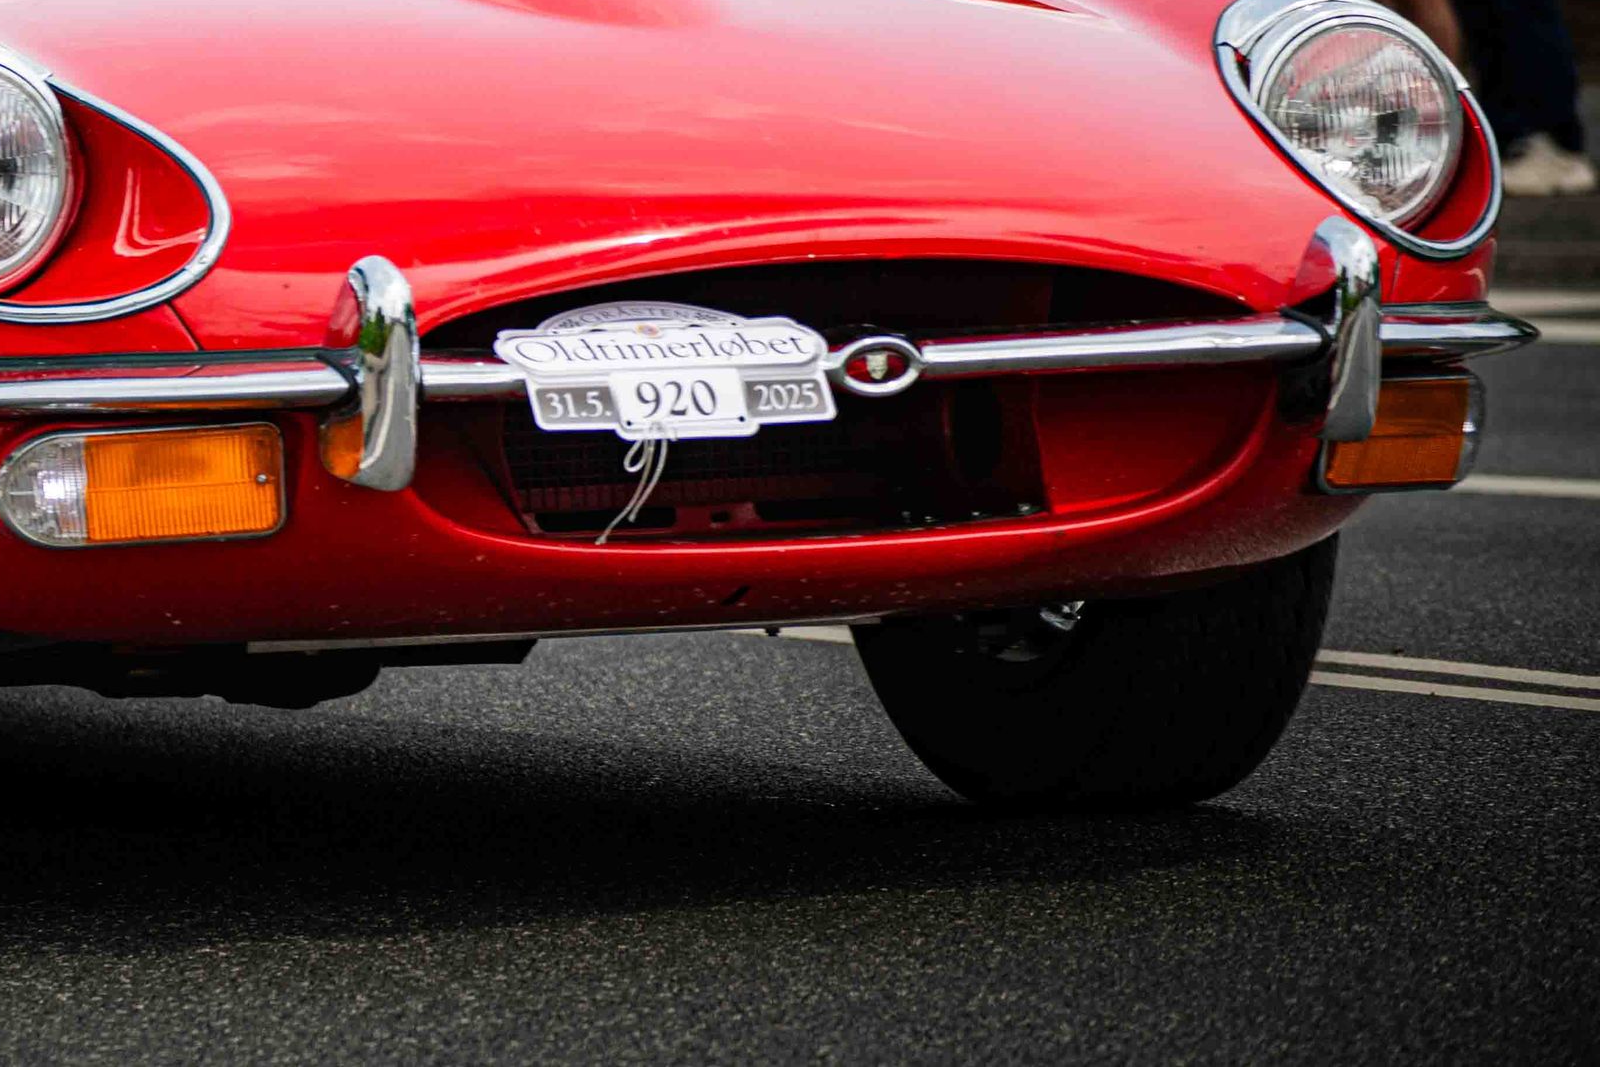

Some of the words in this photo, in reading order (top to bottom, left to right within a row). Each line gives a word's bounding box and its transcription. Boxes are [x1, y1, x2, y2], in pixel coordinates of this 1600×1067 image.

[515, 331, 811, 363] Oldtimerløbet
[545, 391, 613, 419] 31.5.
[636, 379, 717, 419] 920
[753, 382, 819, 411] 2025
